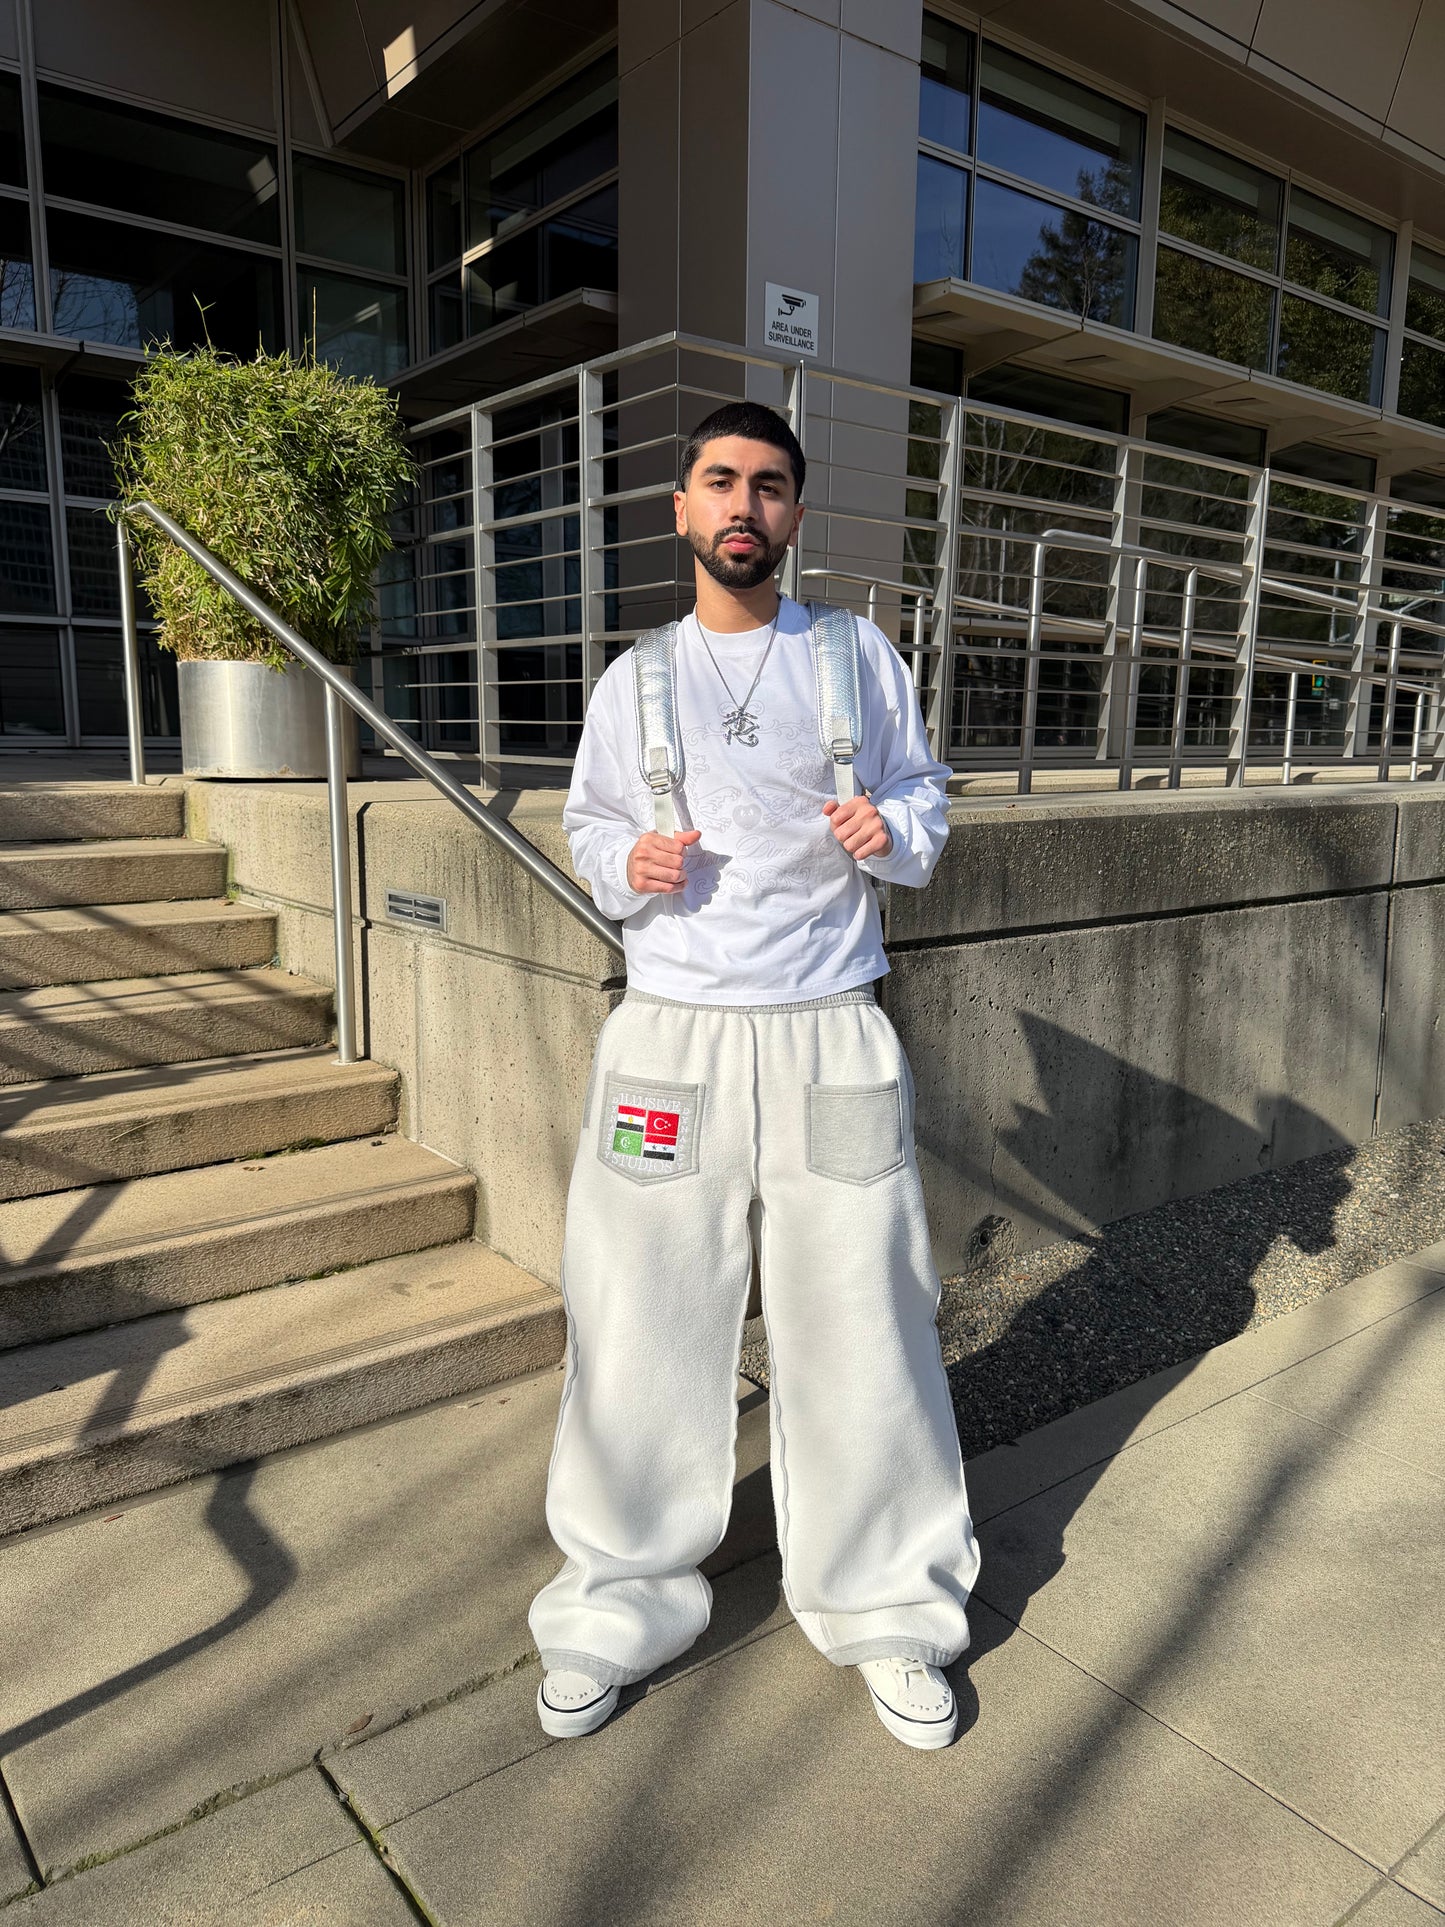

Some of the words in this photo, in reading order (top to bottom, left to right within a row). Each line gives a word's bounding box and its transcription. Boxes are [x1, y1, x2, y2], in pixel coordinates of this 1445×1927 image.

[772, 321, 788, 333] AREA
[791, 326, 811, 338] UNDER
[768, 332, 815, 350] SURVEILLANCE
[619, 1093, 681, 1112] ILLUSIVE
[611, 1153, 672, 1173] STUDIOS
